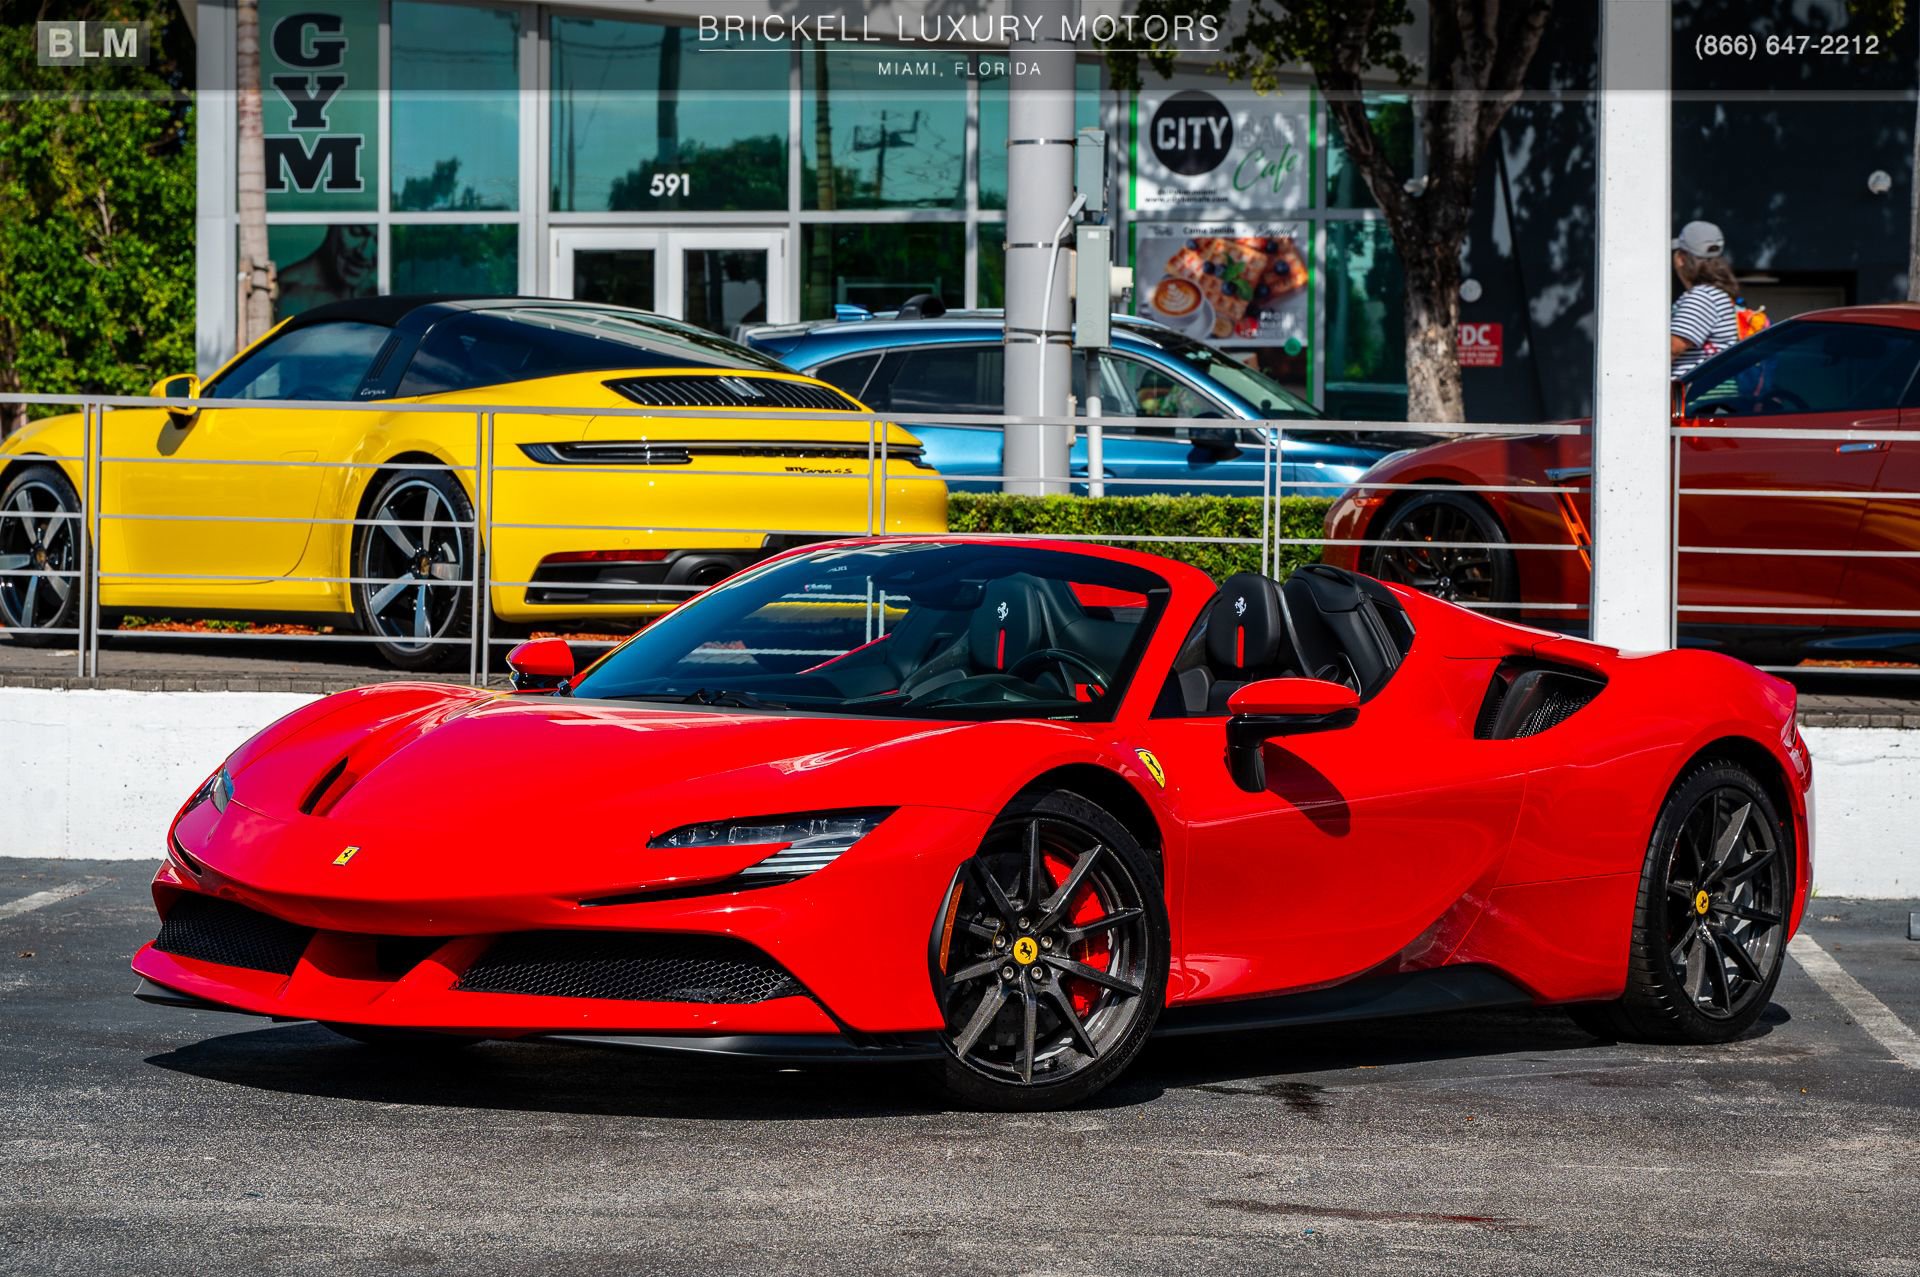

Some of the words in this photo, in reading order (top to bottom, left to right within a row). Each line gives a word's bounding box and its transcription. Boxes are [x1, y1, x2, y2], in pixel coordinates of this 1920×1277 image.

[263, 12, 364, 193] GYM
[1157, 116, 1229, 150] CITY
[649, 173, 690, 197] 591
